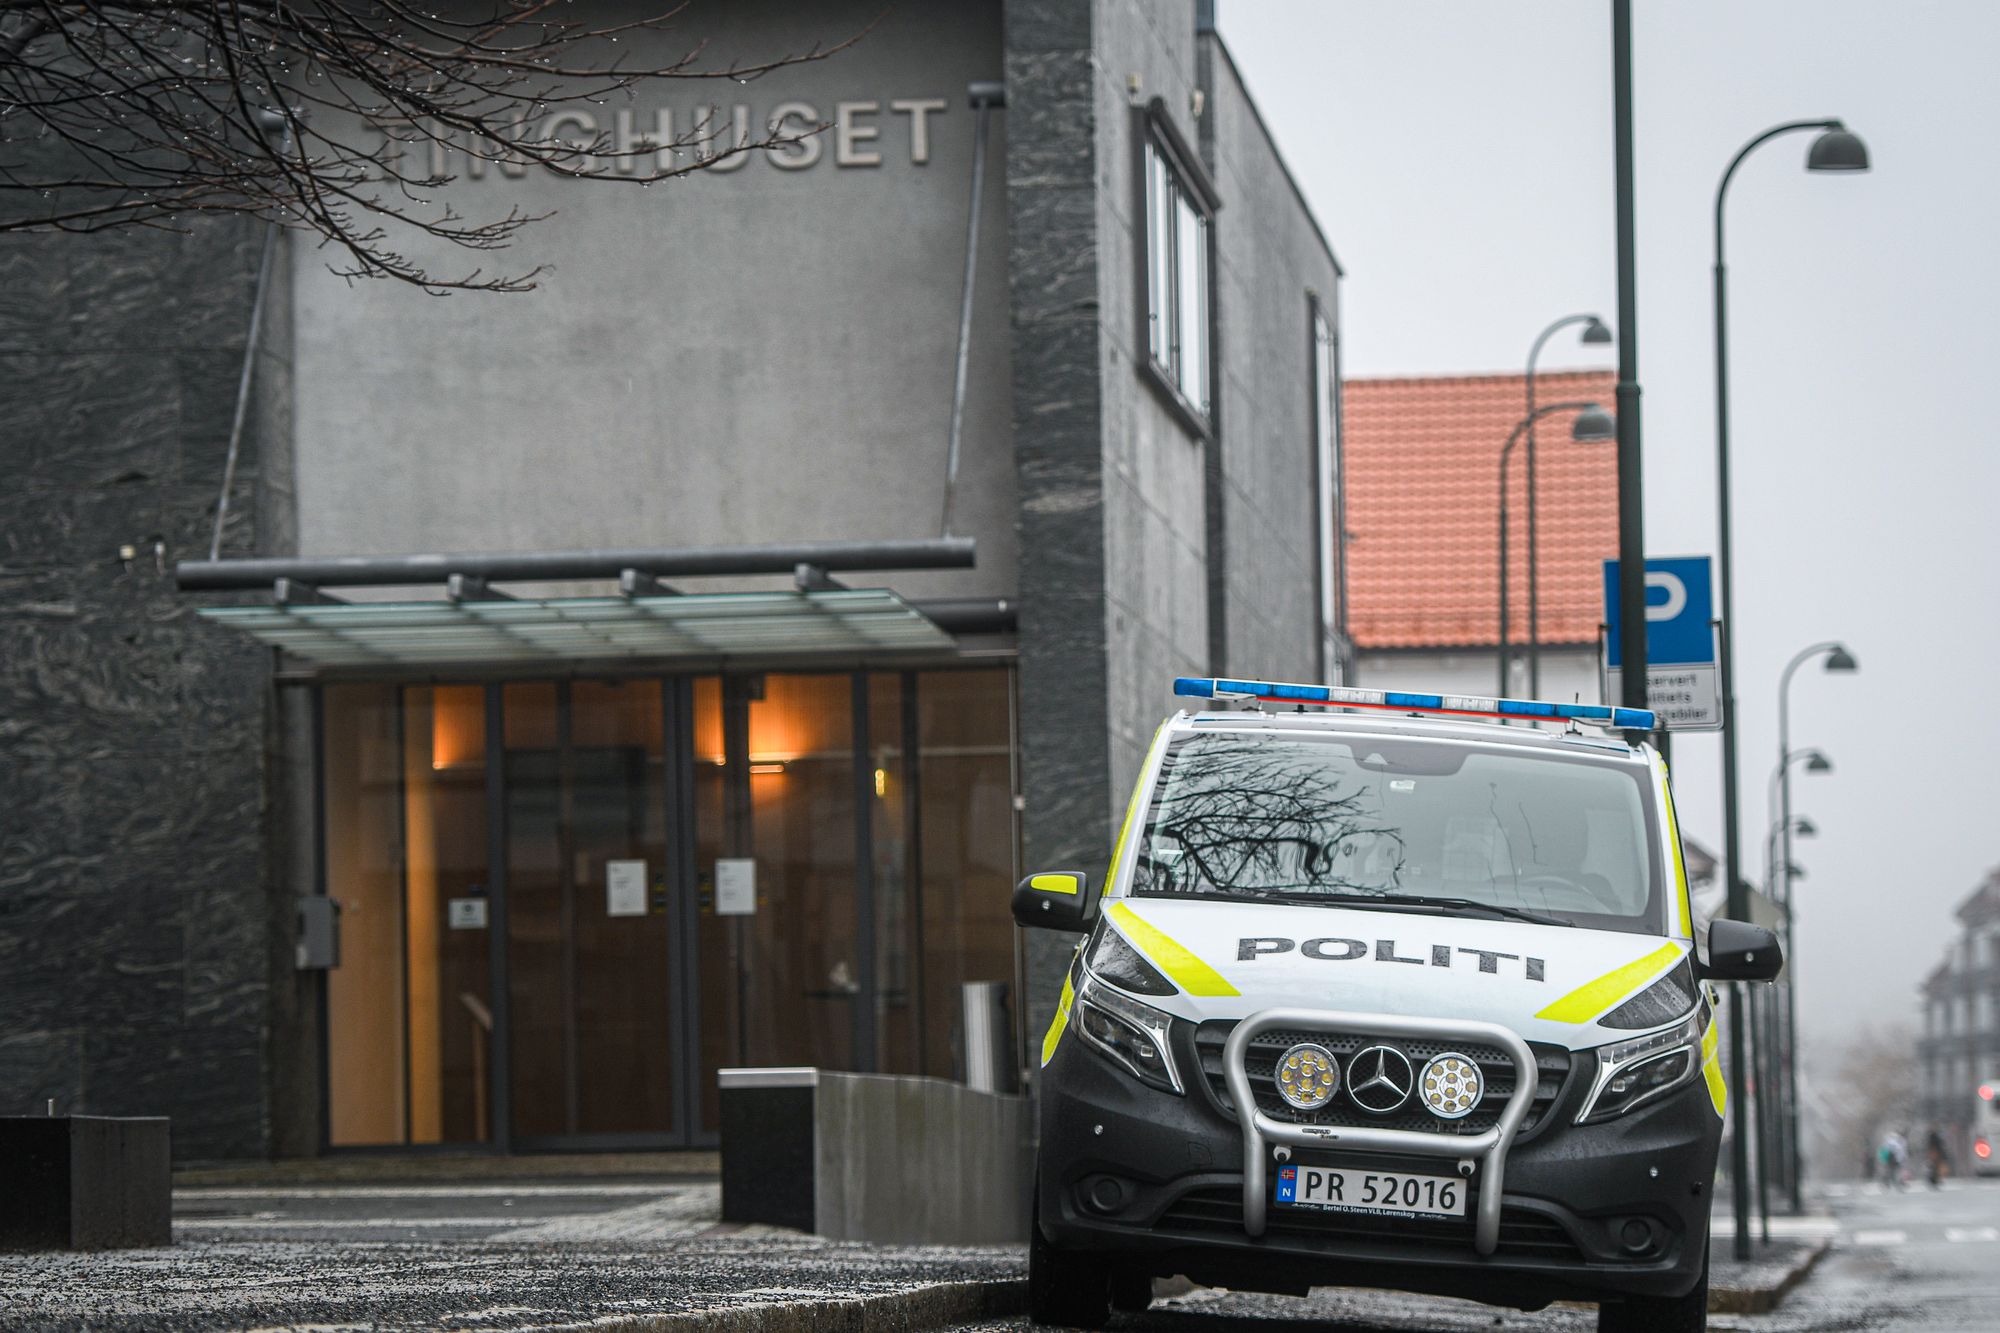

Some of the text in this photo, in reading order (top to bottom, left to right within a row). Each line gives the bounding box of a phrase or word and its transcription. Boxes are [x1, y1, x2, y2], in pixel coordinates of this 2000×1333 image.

[362, 98, 948, 183] TINGHUSET
[1237, 937, 1545, 982] POLITI
[1282, 1187, 1291, 1197] N
[1305, 1171, 1456, 1210] PR 52016
[1322, 1203, 1342, 1212] Bertel
[1350, 1206, 1368, 1214] Steen
